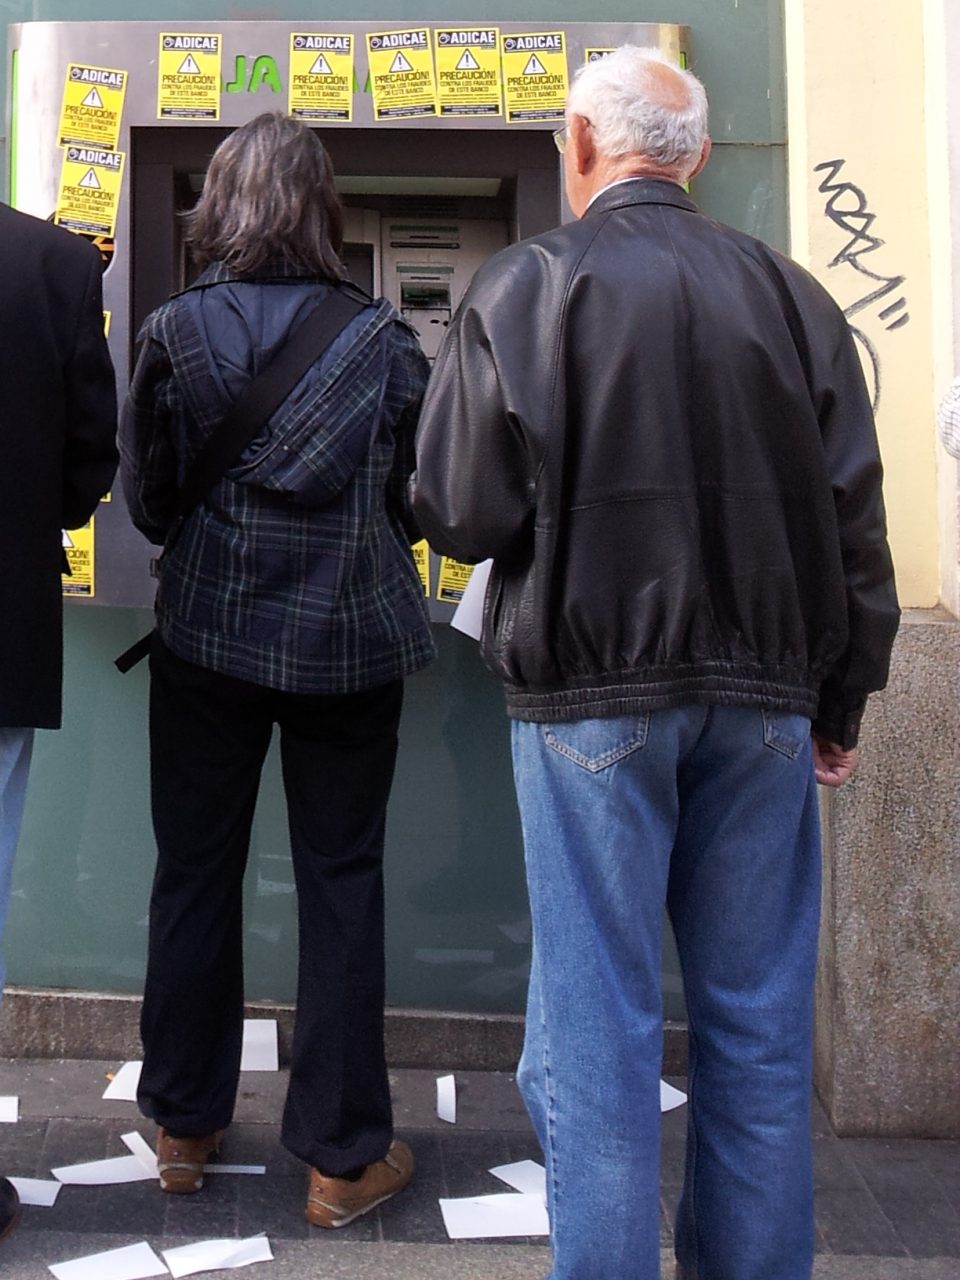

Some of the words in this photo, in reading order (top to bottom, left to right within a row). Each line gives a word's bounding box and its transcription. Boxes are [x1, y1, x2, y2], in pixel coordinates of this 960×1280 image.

[174, 36, 217, 49] ADICAE
[305, 36, 349, 49] ADICAE
[382, 32, 426, 47] ADICAE
[450, 31, 495, 44] ADICAE
[516, 35, 561, 49] ADICAE
[81, 69, 123, 85] ADICAE
[225, 54, 282, 93] JA
[78, 150, 120, 166] ADICAE
